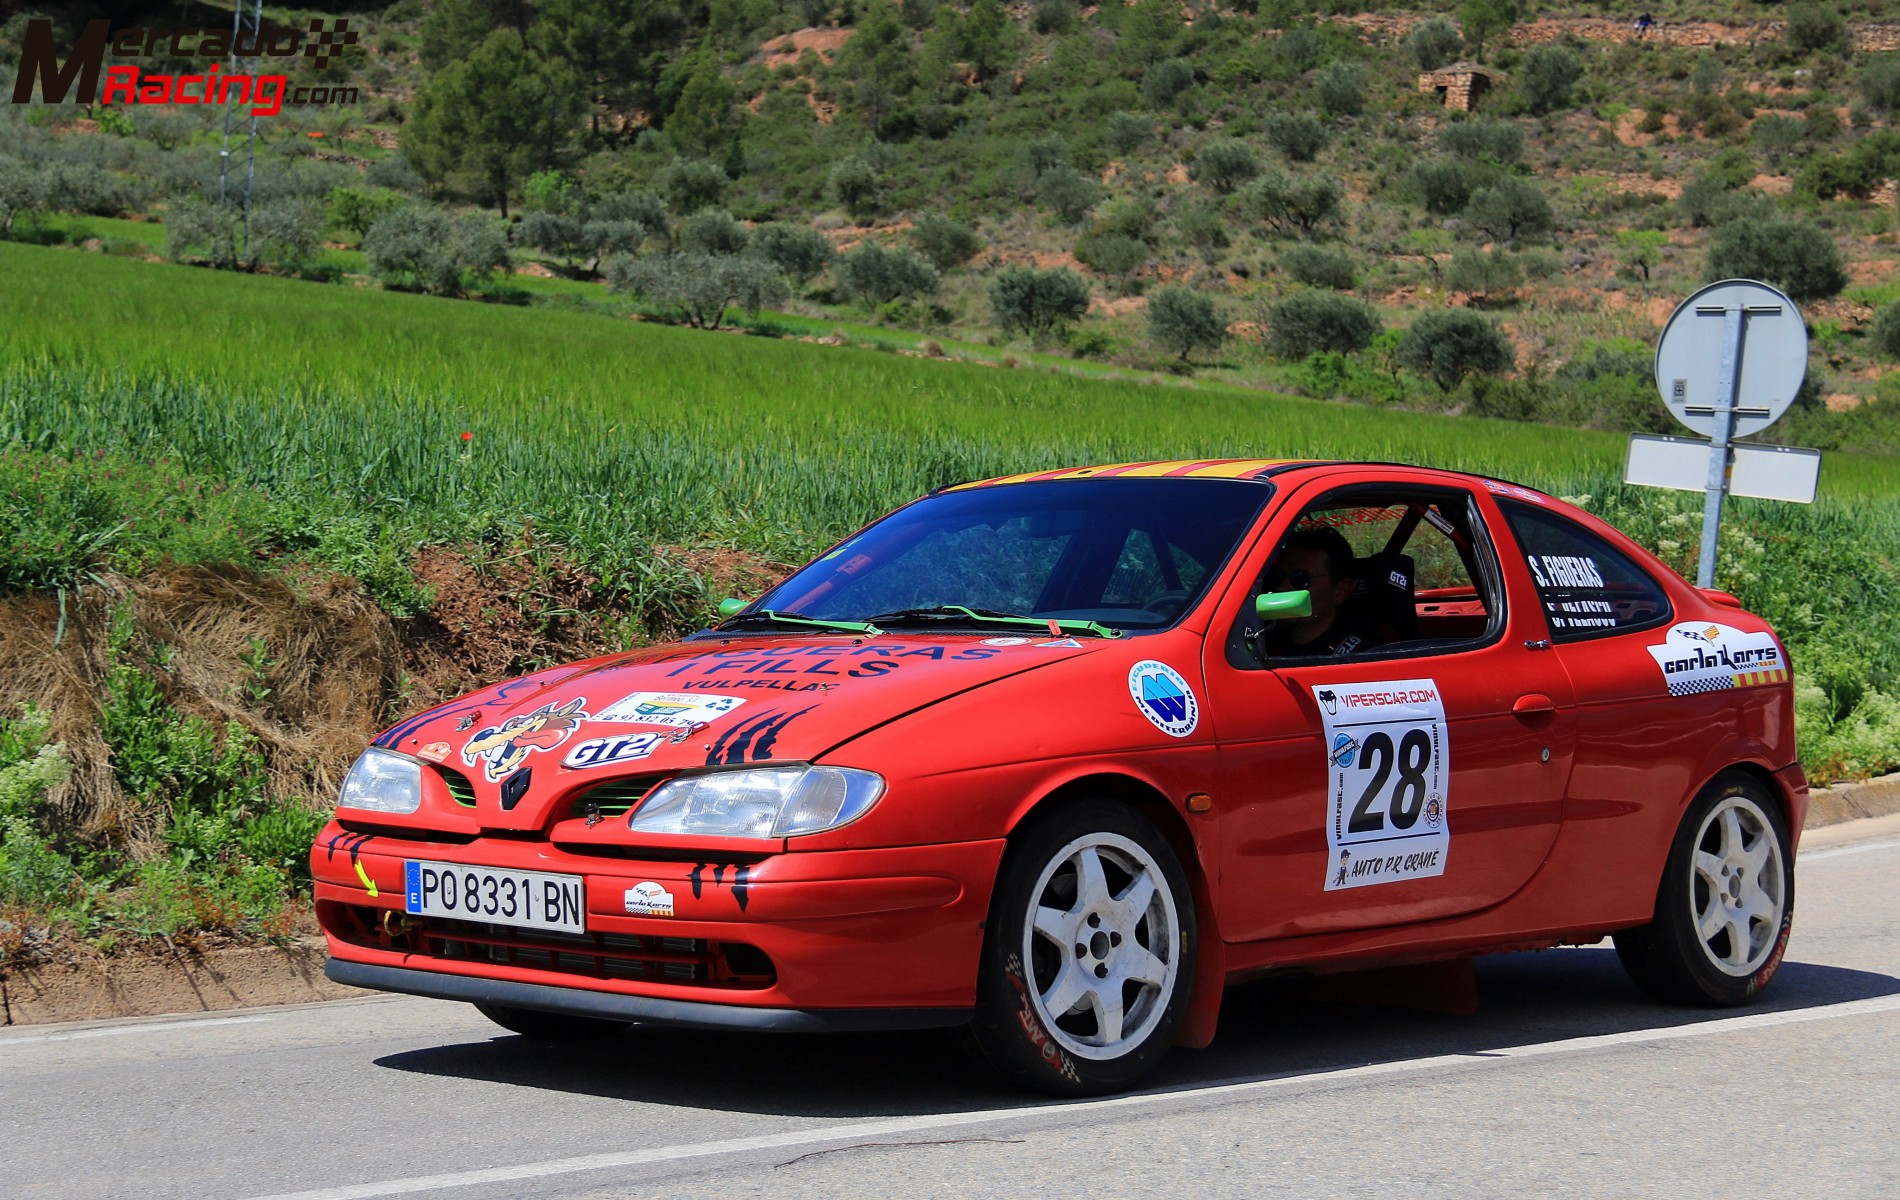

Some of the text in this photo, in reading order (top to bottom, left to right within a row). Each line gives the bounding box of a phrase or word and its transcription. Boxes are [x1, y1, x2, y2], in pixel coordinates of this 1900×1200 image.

[1541, 556, 1604, 587] FIGUERAS
[651, 645, 1001, 665] FIGUERAS
[703, 659, 900, 677] FILLS
[1132, 663, 1184, 691] ESCUDERIA
[1340, 689, 1438, 708] VIPERSCAR.COM
[1347, 728, 1432, 833] 28
[1351, 857, 1383, 878] AUTO
[411, 892, 418, 904] E
[464, 872, 531, 920] 8331
[543, 880, 580, 926] BN
